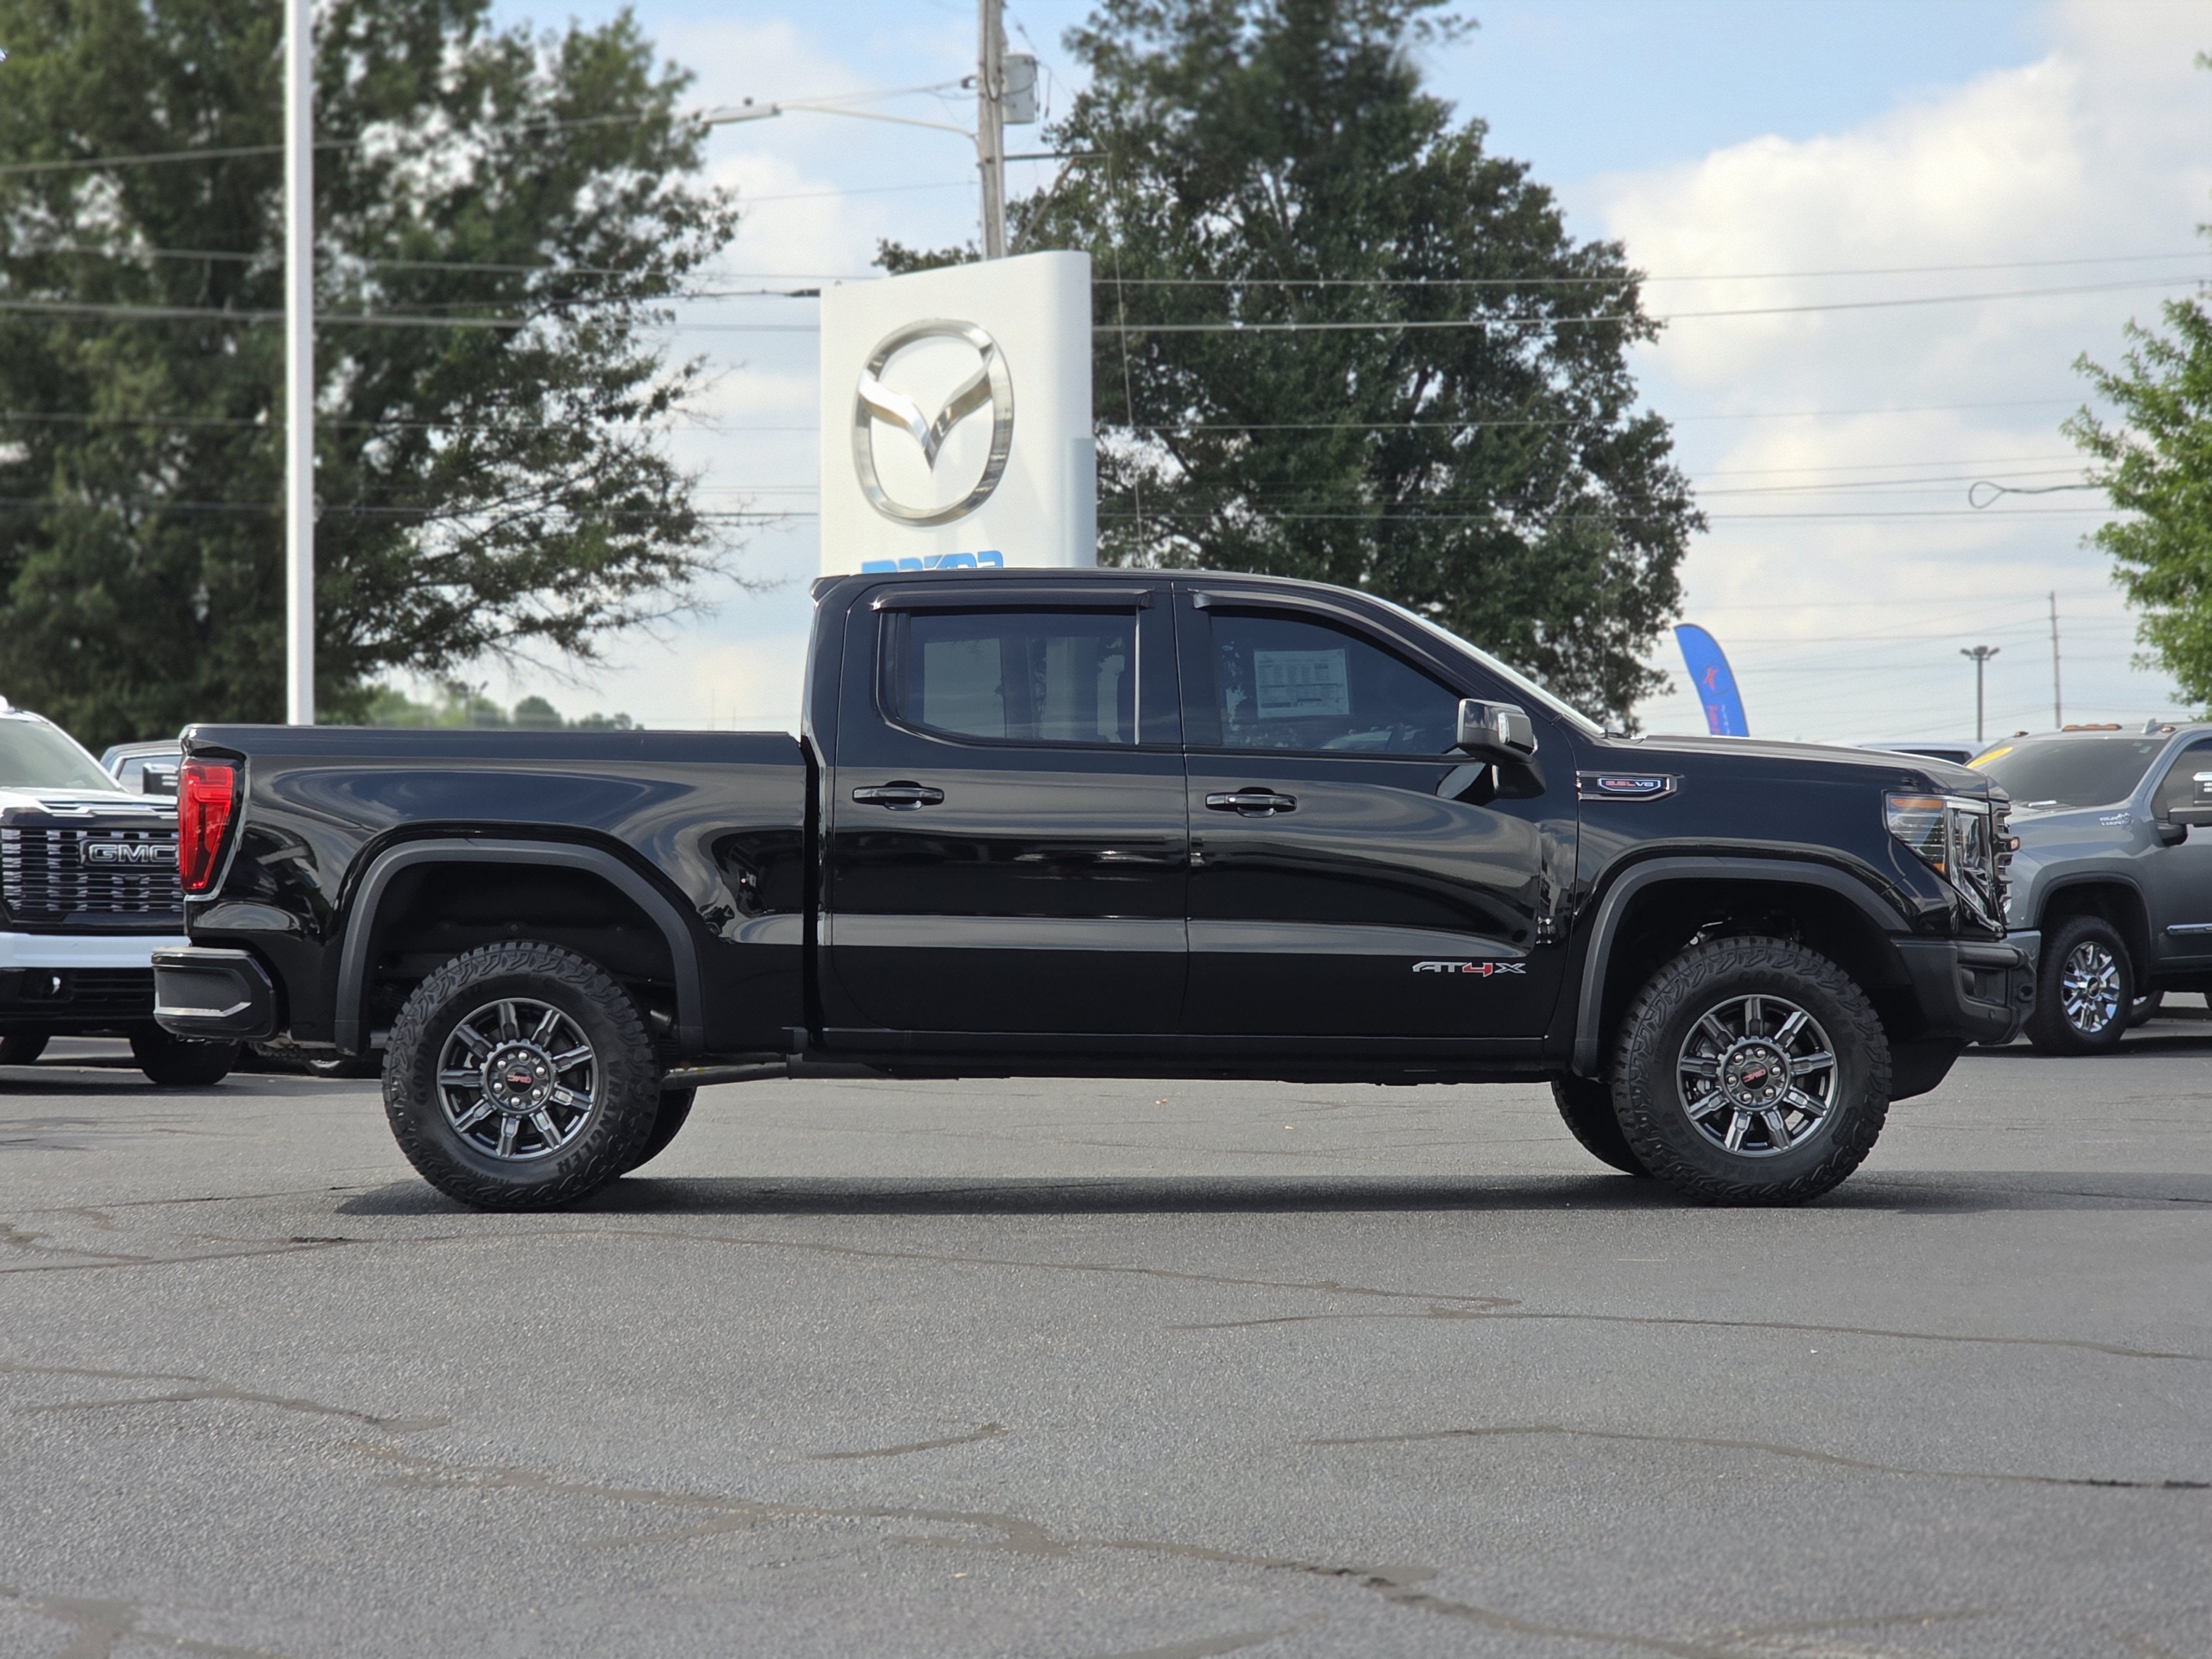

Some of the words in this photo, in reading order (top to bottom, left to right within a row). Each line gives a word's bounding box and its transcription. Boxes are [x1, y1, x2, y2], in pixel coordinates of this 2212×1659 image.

[89, 844, 176, 863] GMC
[1412, 961, 1526, 978] AT4X
[555, 1059, 623, 1175] WRANGLER
